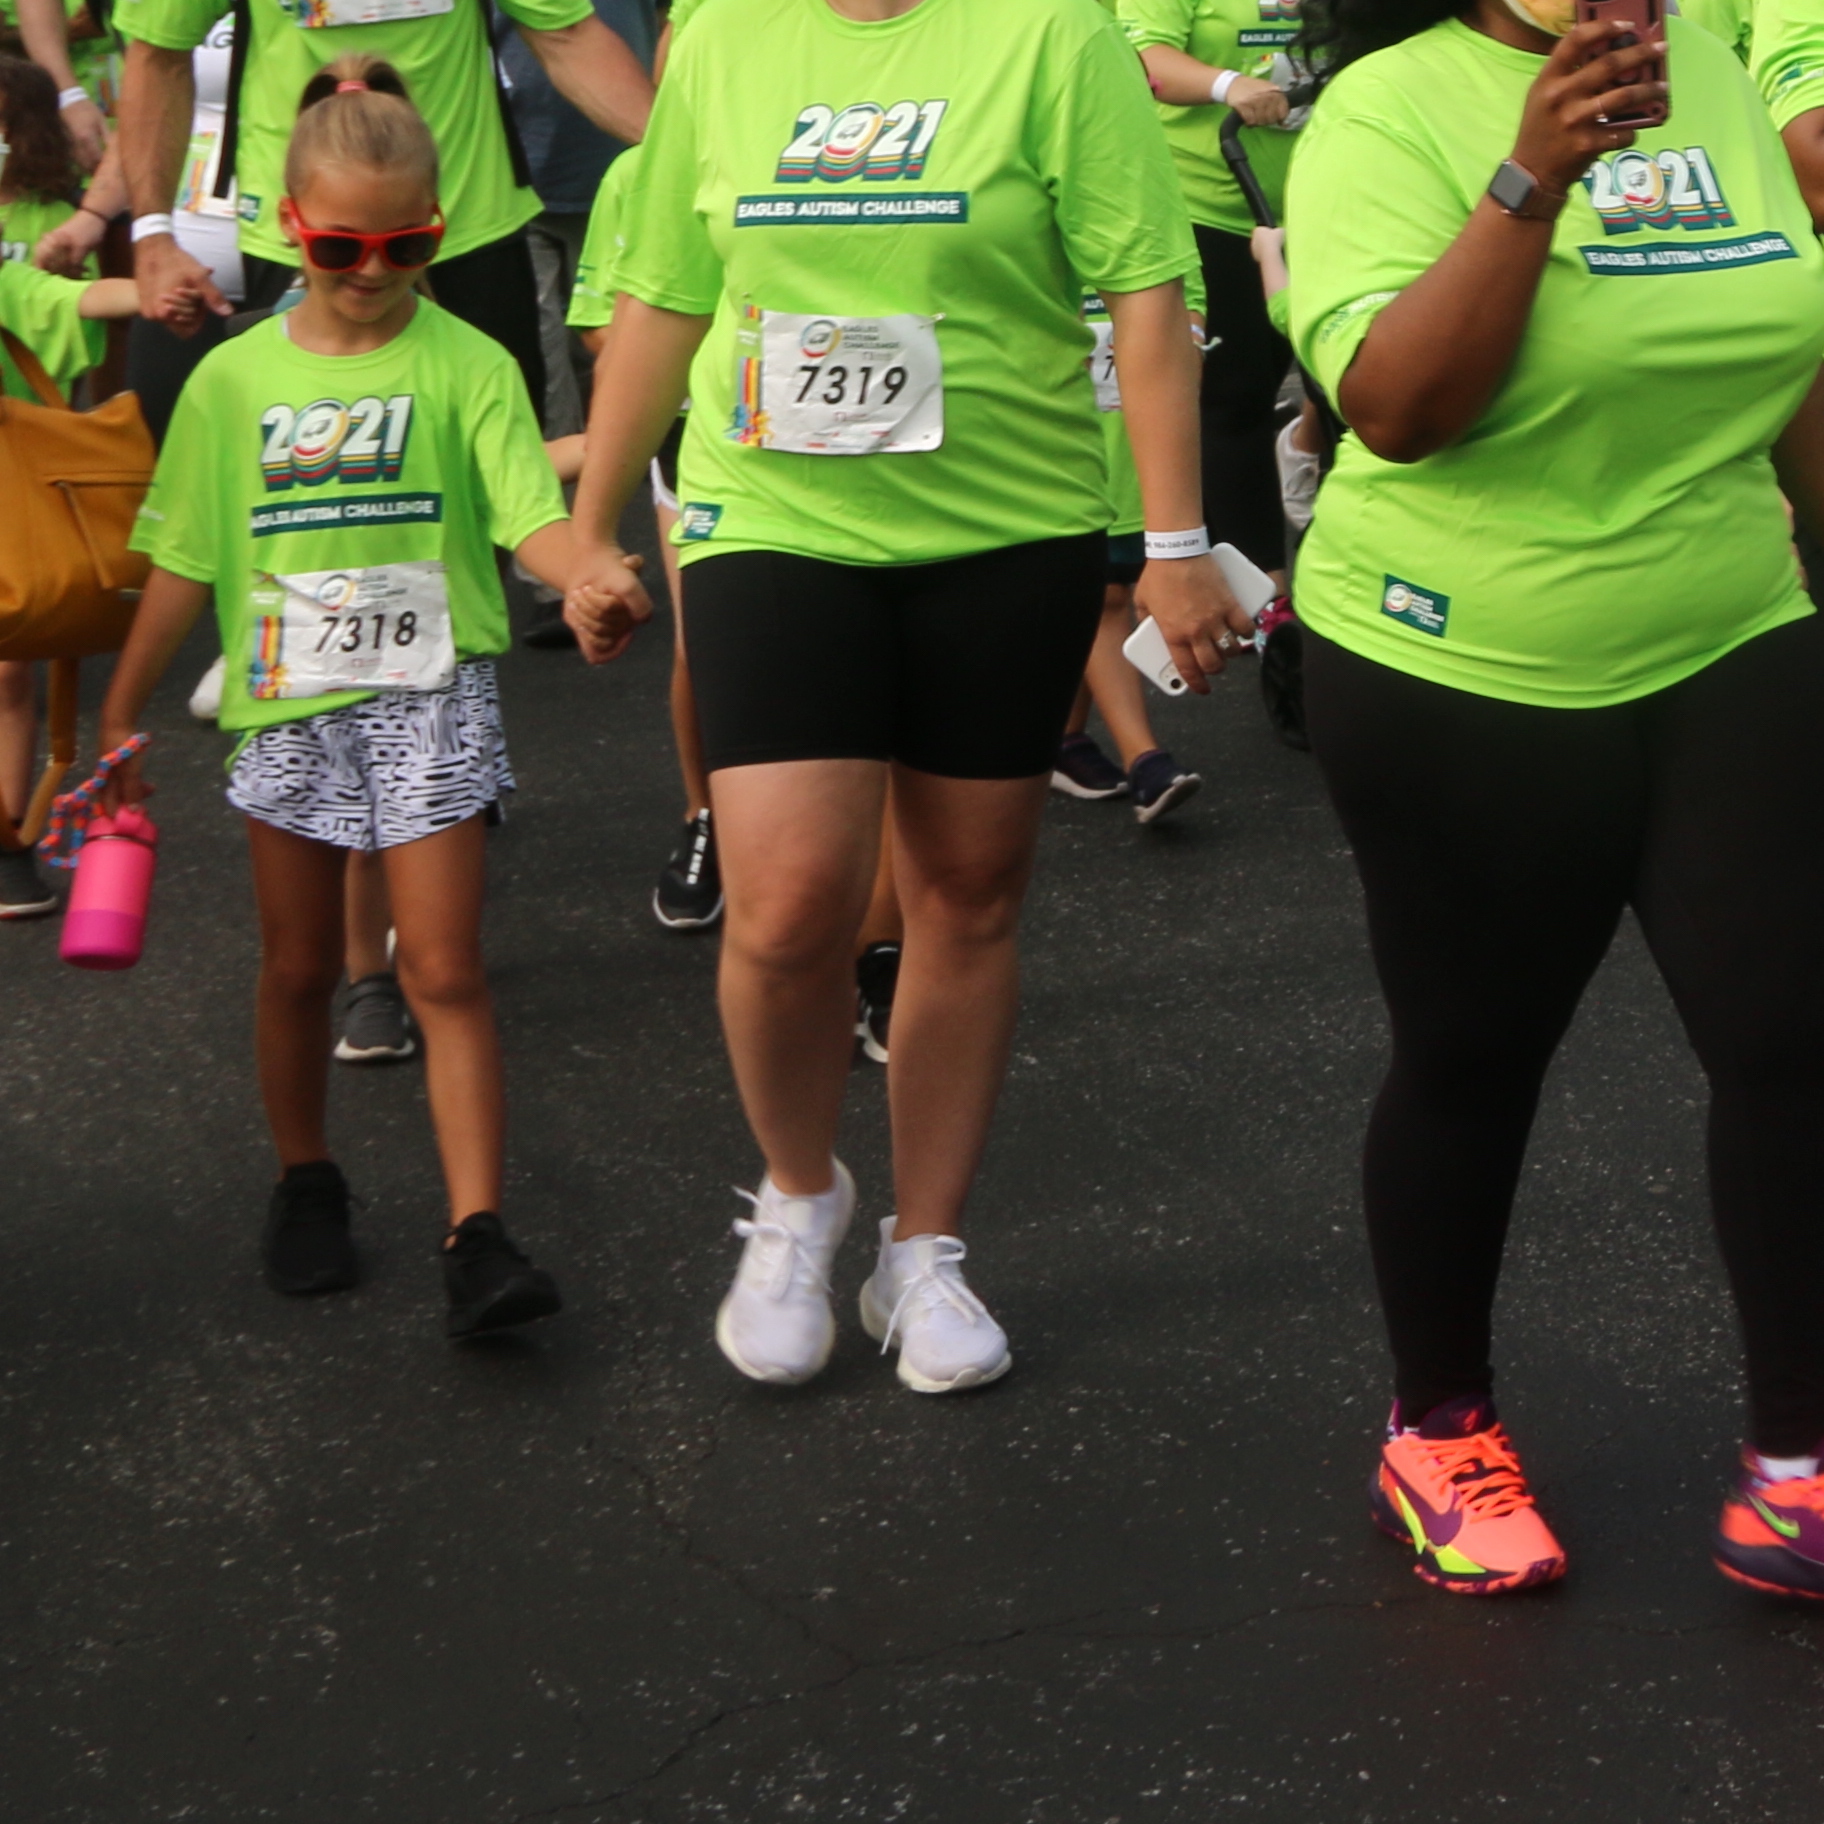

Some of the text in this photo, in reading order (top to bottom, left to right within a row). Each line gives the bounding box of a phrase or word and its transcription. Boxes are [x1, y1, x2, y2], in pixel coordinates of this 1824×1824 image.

[1240, 33, 1273, 44] EAGLES
[778, 99, 948, 174] 2021
[1582, 146, 1727, 224] 2021
[737, 199, 960, 218] EAGLES AUTISM CHALLENGE
[1586, 238, 1791, 267] EAGLES AUTISM CHALLENGE
[795, 365, 908, 406] 7319
[261, 394, 414, 478] 2021
[344, 499, 435, 519] CHALLENGE
[314, 610, 418, 653] 7318
